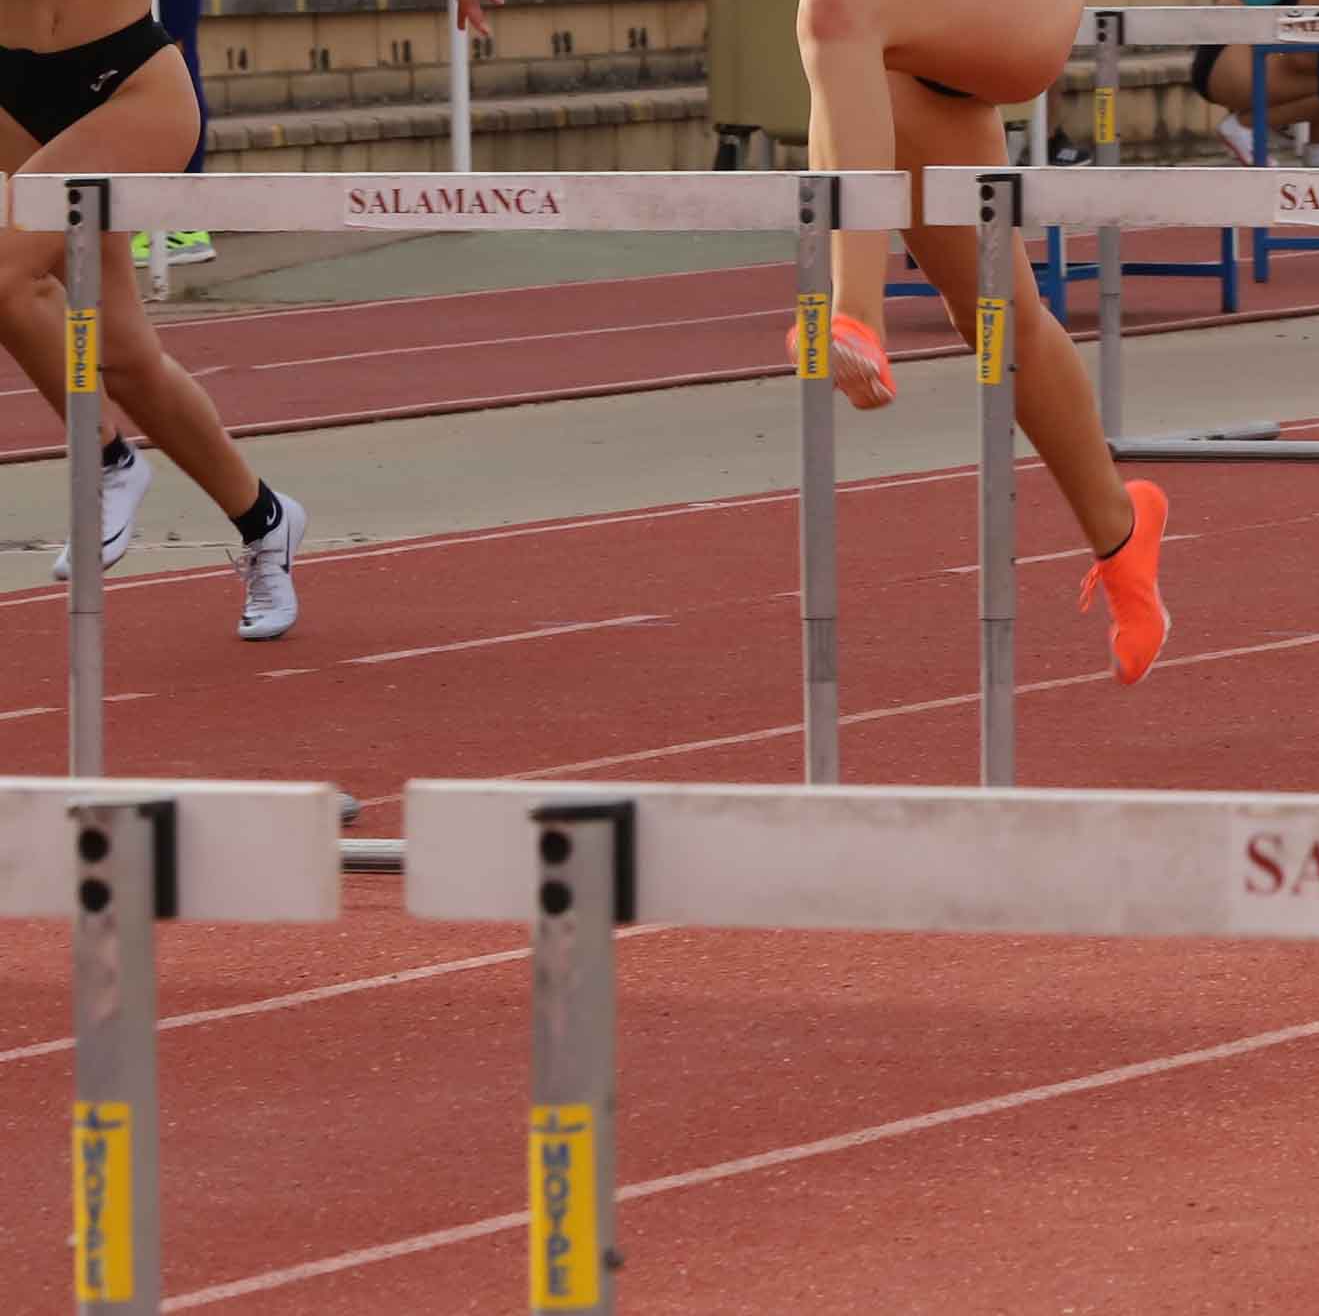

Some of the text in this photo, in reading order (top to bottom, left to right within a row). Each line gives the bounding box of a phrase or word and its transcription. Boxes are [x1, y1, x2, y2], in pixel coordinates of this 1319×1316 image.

[349, 188, 560, 214] SALAMANCA
[73, 324, 87, 388] MOYPE
[805, 309, 818, 374] MOYPE
[82, 1137, 107, 1291] MOYPE
[540, 1142, 572, 1297] MOYPE
